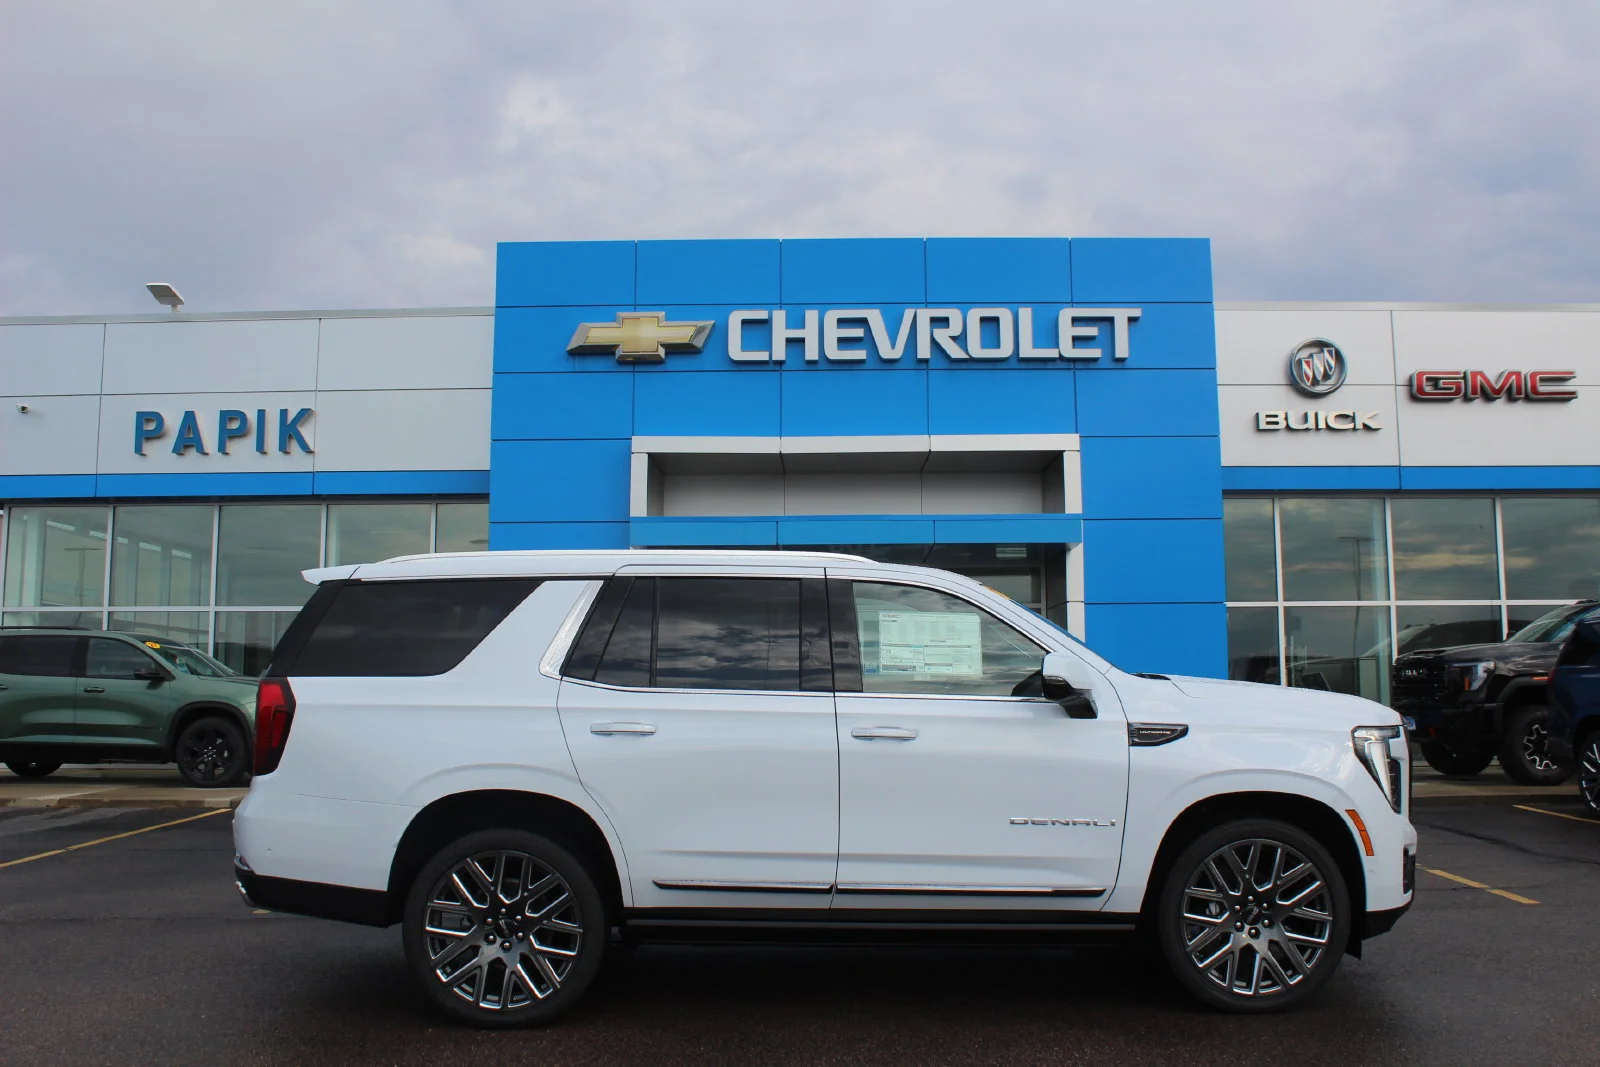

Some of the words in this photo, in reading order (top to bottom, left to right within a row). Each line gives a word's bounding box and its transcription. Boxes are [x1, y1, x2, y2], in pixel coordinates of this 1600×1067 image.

[727, 307, 1142, 363] CHEVROLET
[1410, 369, 1578, 402] GMC
[134, 408, 315, 455] PAPIK
[1256, 410, 1383, 431] BUICK
[1009, 817, 1116, 827] DENALI
